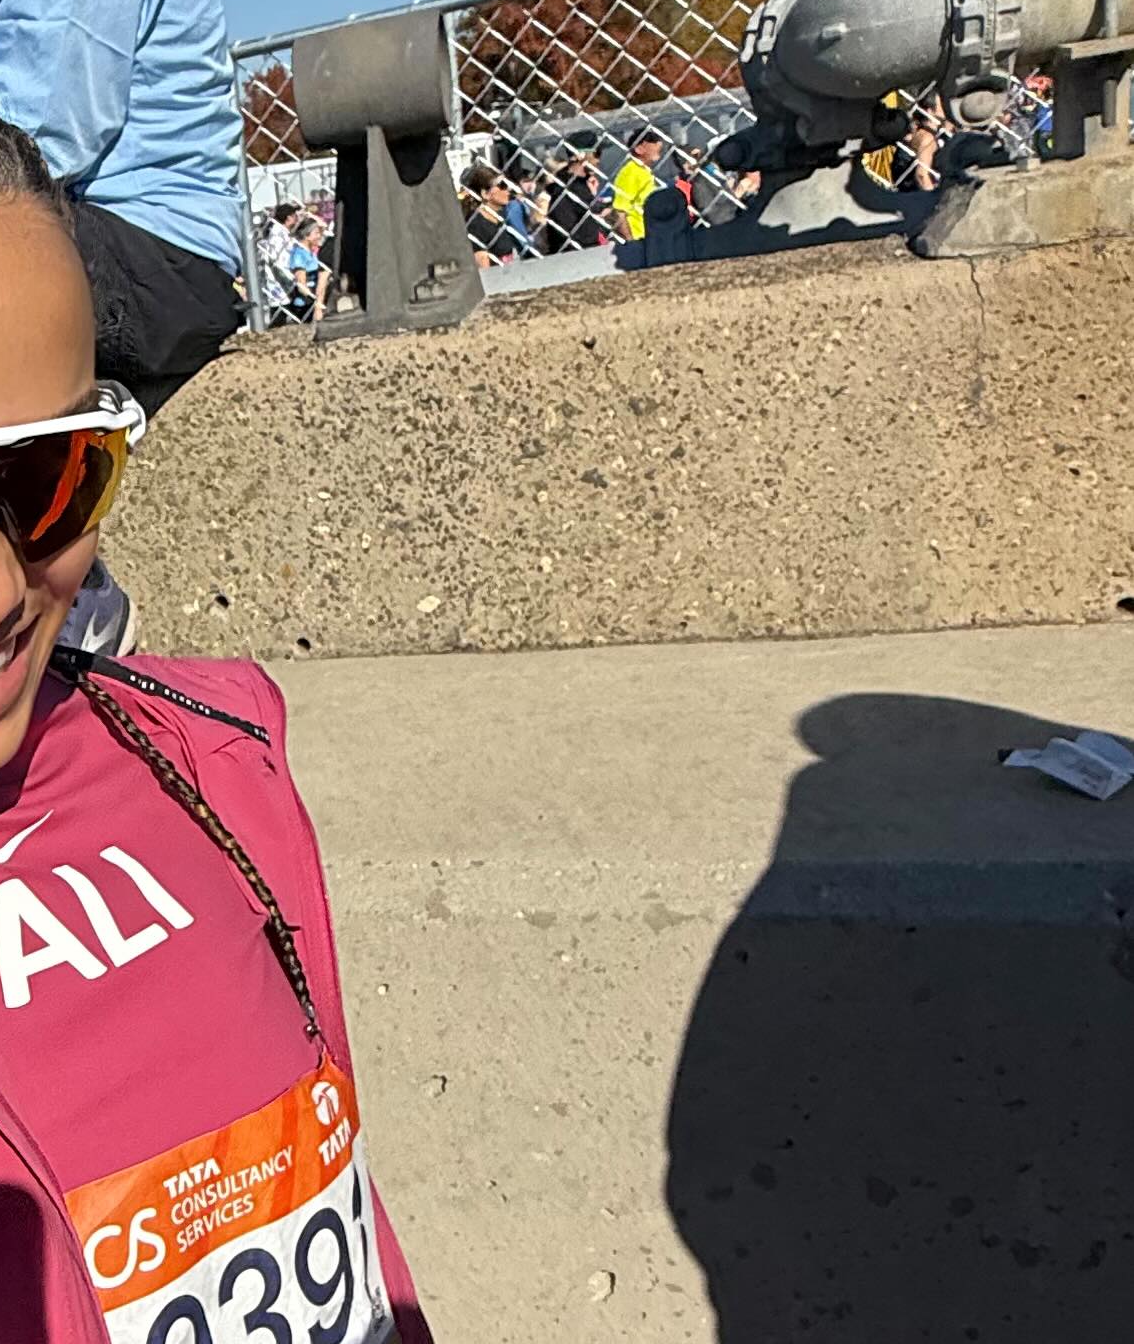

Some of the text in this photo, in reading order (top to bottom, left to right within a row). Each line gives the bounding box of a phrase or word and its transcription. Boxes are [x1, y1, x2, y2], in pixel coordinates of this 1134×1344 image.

[318, 1117, 352, 1166] TATA
[162, 1157, 222, 1199] TATA
[170, 1145, 293, 1226] CONSULTANCY
[175, 1193, 254, 1253] SERVICES
